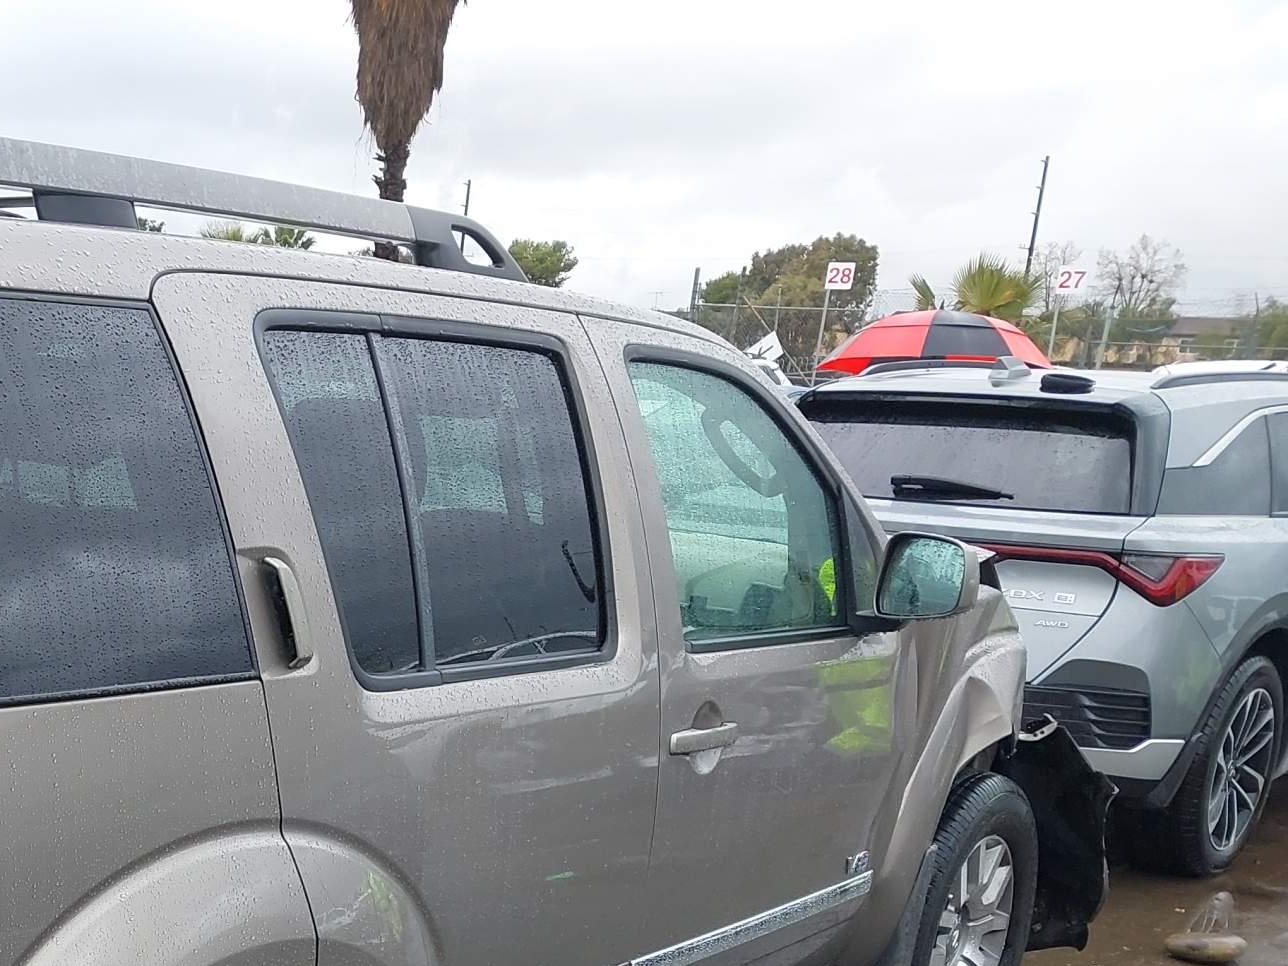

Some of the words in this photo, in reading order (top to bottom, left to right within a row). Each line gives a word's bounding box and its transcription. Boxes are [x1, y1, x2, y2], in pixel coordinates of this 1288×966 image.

[827, 267, 852, 284] 28
[1058, 270, 1087, 289] 27
[1033, 619, 1069, 628] AWD
